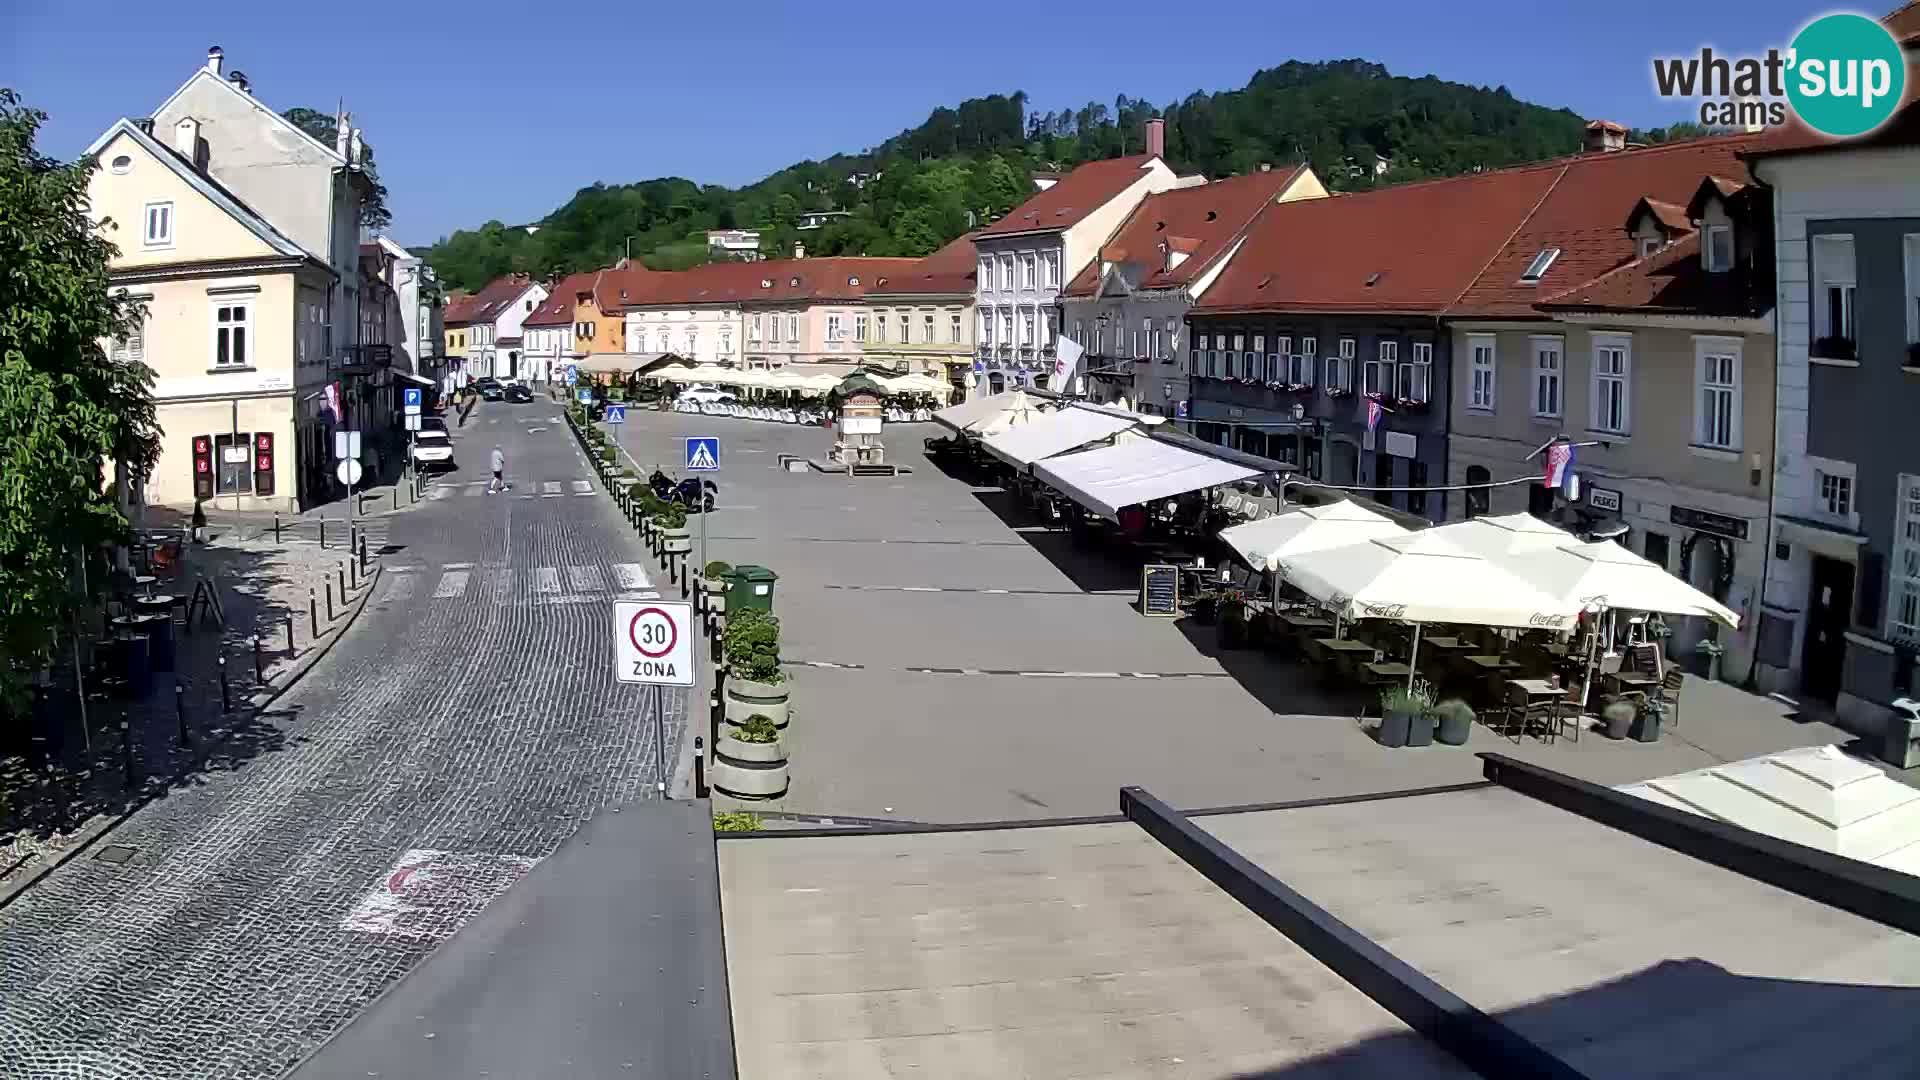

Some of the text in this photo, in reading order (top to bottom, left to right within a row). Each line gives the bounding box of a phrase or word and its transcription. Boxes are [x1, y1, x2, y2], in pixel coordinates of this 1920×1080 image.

[408, 392, 417, 404] P
[642, 623, 666, 645] 30
[633, 661, 676, 677] ZONA
